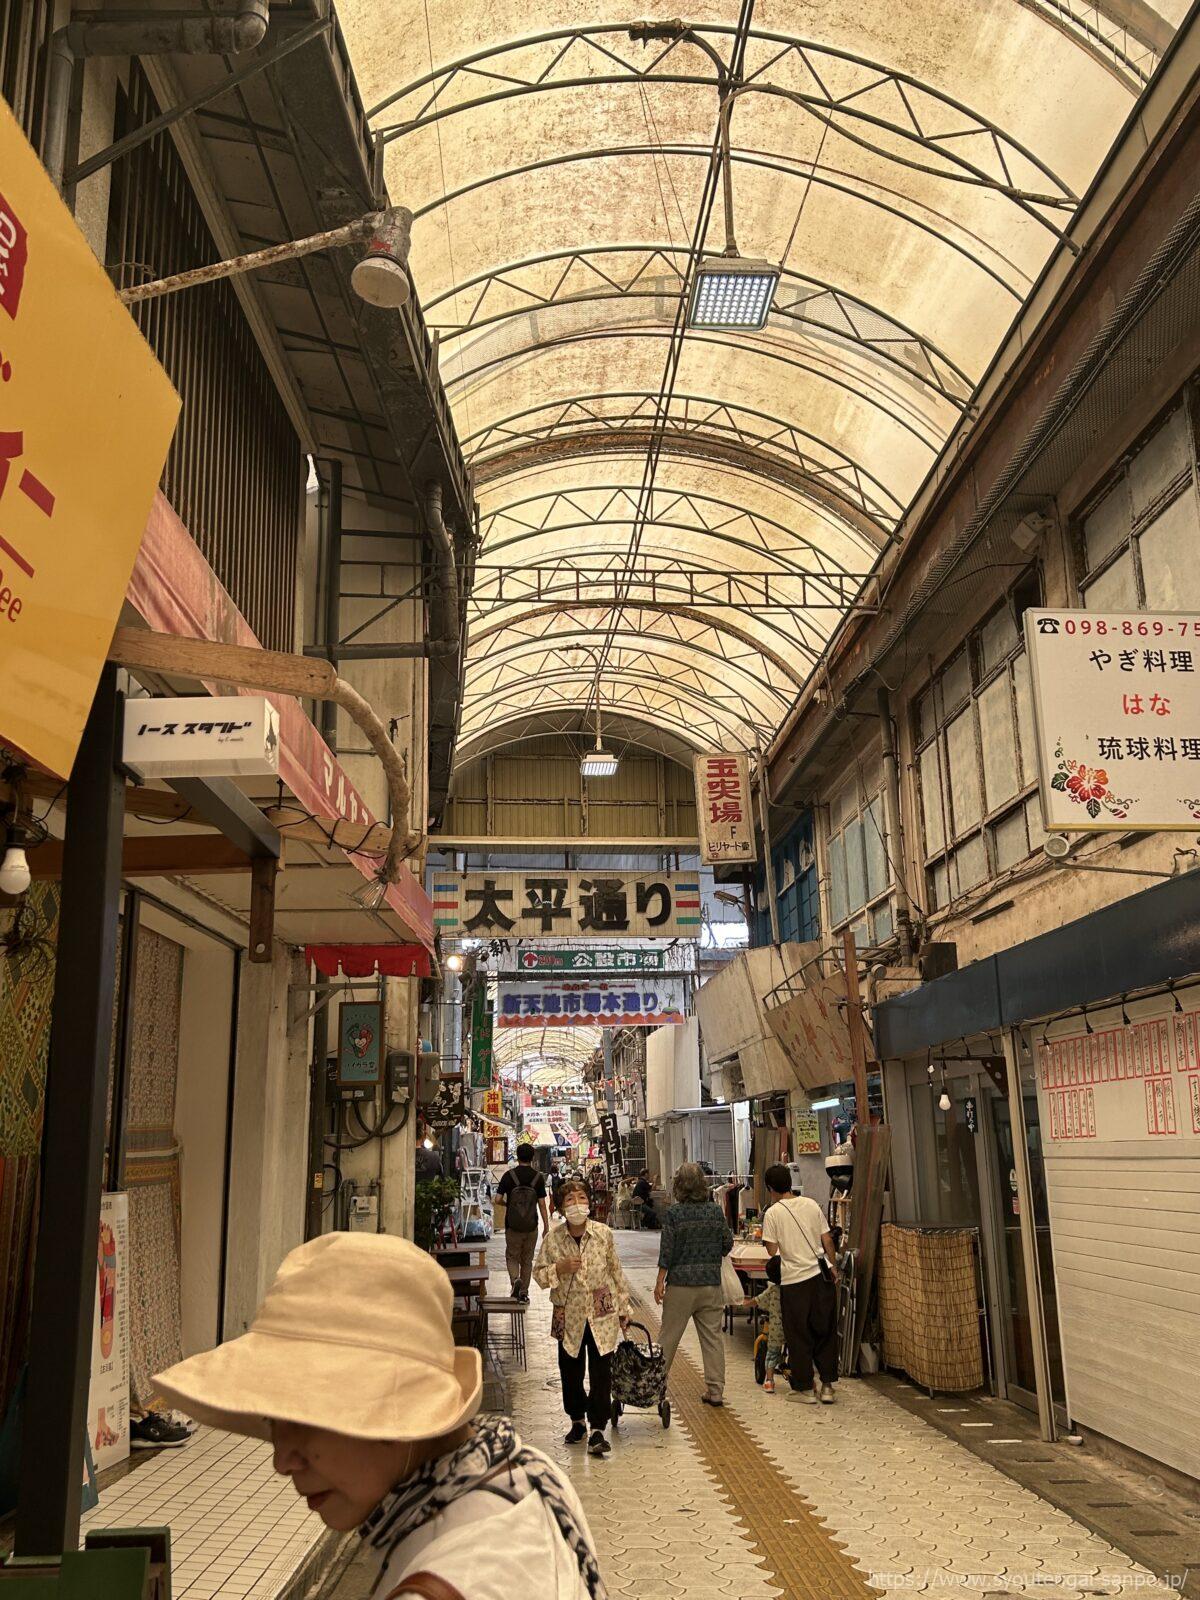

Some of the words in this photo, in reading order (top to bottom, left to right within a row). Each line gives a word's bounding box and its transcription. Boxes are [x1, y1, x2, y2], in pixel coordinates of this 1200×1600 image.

[1089, 649, 1194, 672] やぎ料理
[1122, 693, 1171, 716] はな
[1097, 736, 1200, 761] 琉球料理
[707, 759, 742, 824] 玉突場
[463, 878, 673, 932] 太平通り
[572, 951, 659, 968] 公設市場
[503, 992, 658, 1014] 新天地市場本通り
